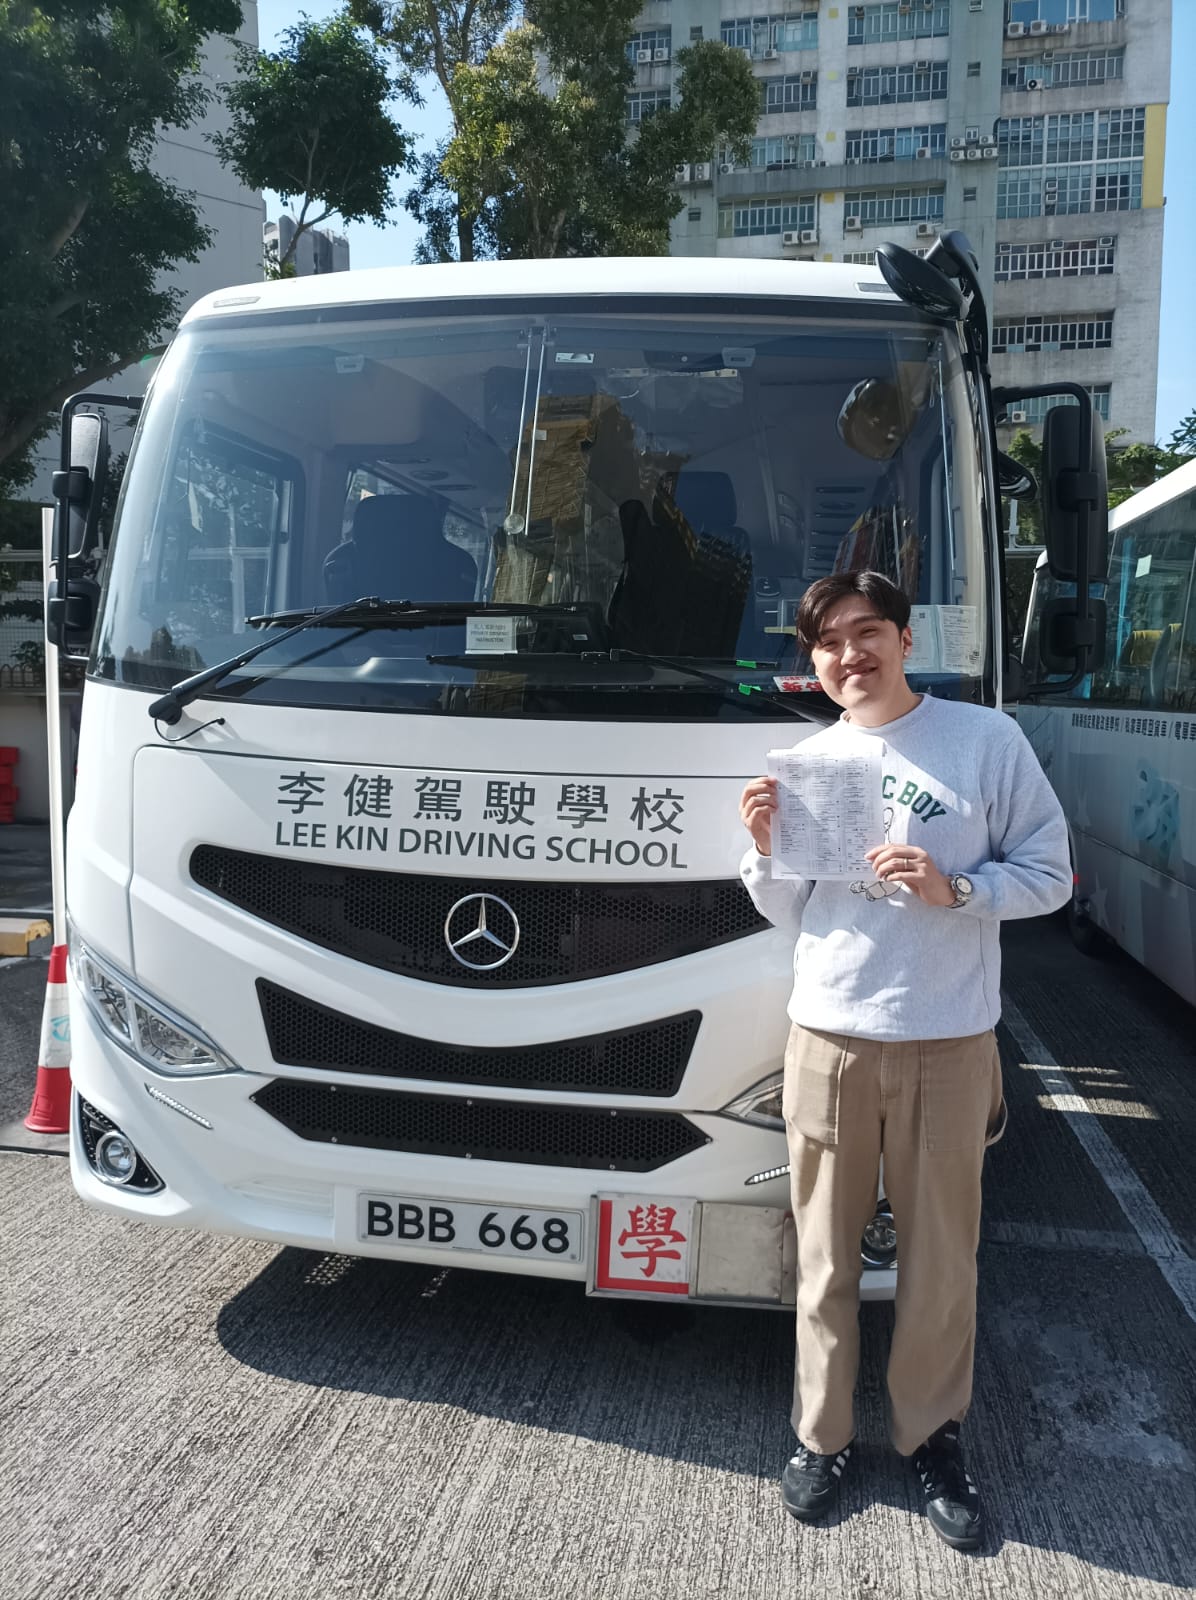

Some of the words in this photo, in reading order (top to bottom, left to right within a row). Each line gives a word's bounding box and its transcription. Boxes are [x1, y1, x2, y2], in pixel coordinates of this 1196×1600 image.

[277, 771, 685, 835] 李健駕駛學校
[896, 780, 947, 824] BOY
[275, 821, 327, 848] LEE
[336, 825, 389, 852] KIN
[399, 828, 536, 860] DRIVING
[545, 836, 688, 869] SCHOOL
[367, 1200, 456, 1243] BBB
[478, 1212, 570, 1254] 668
[617, 1203, 687, 1278] 學
